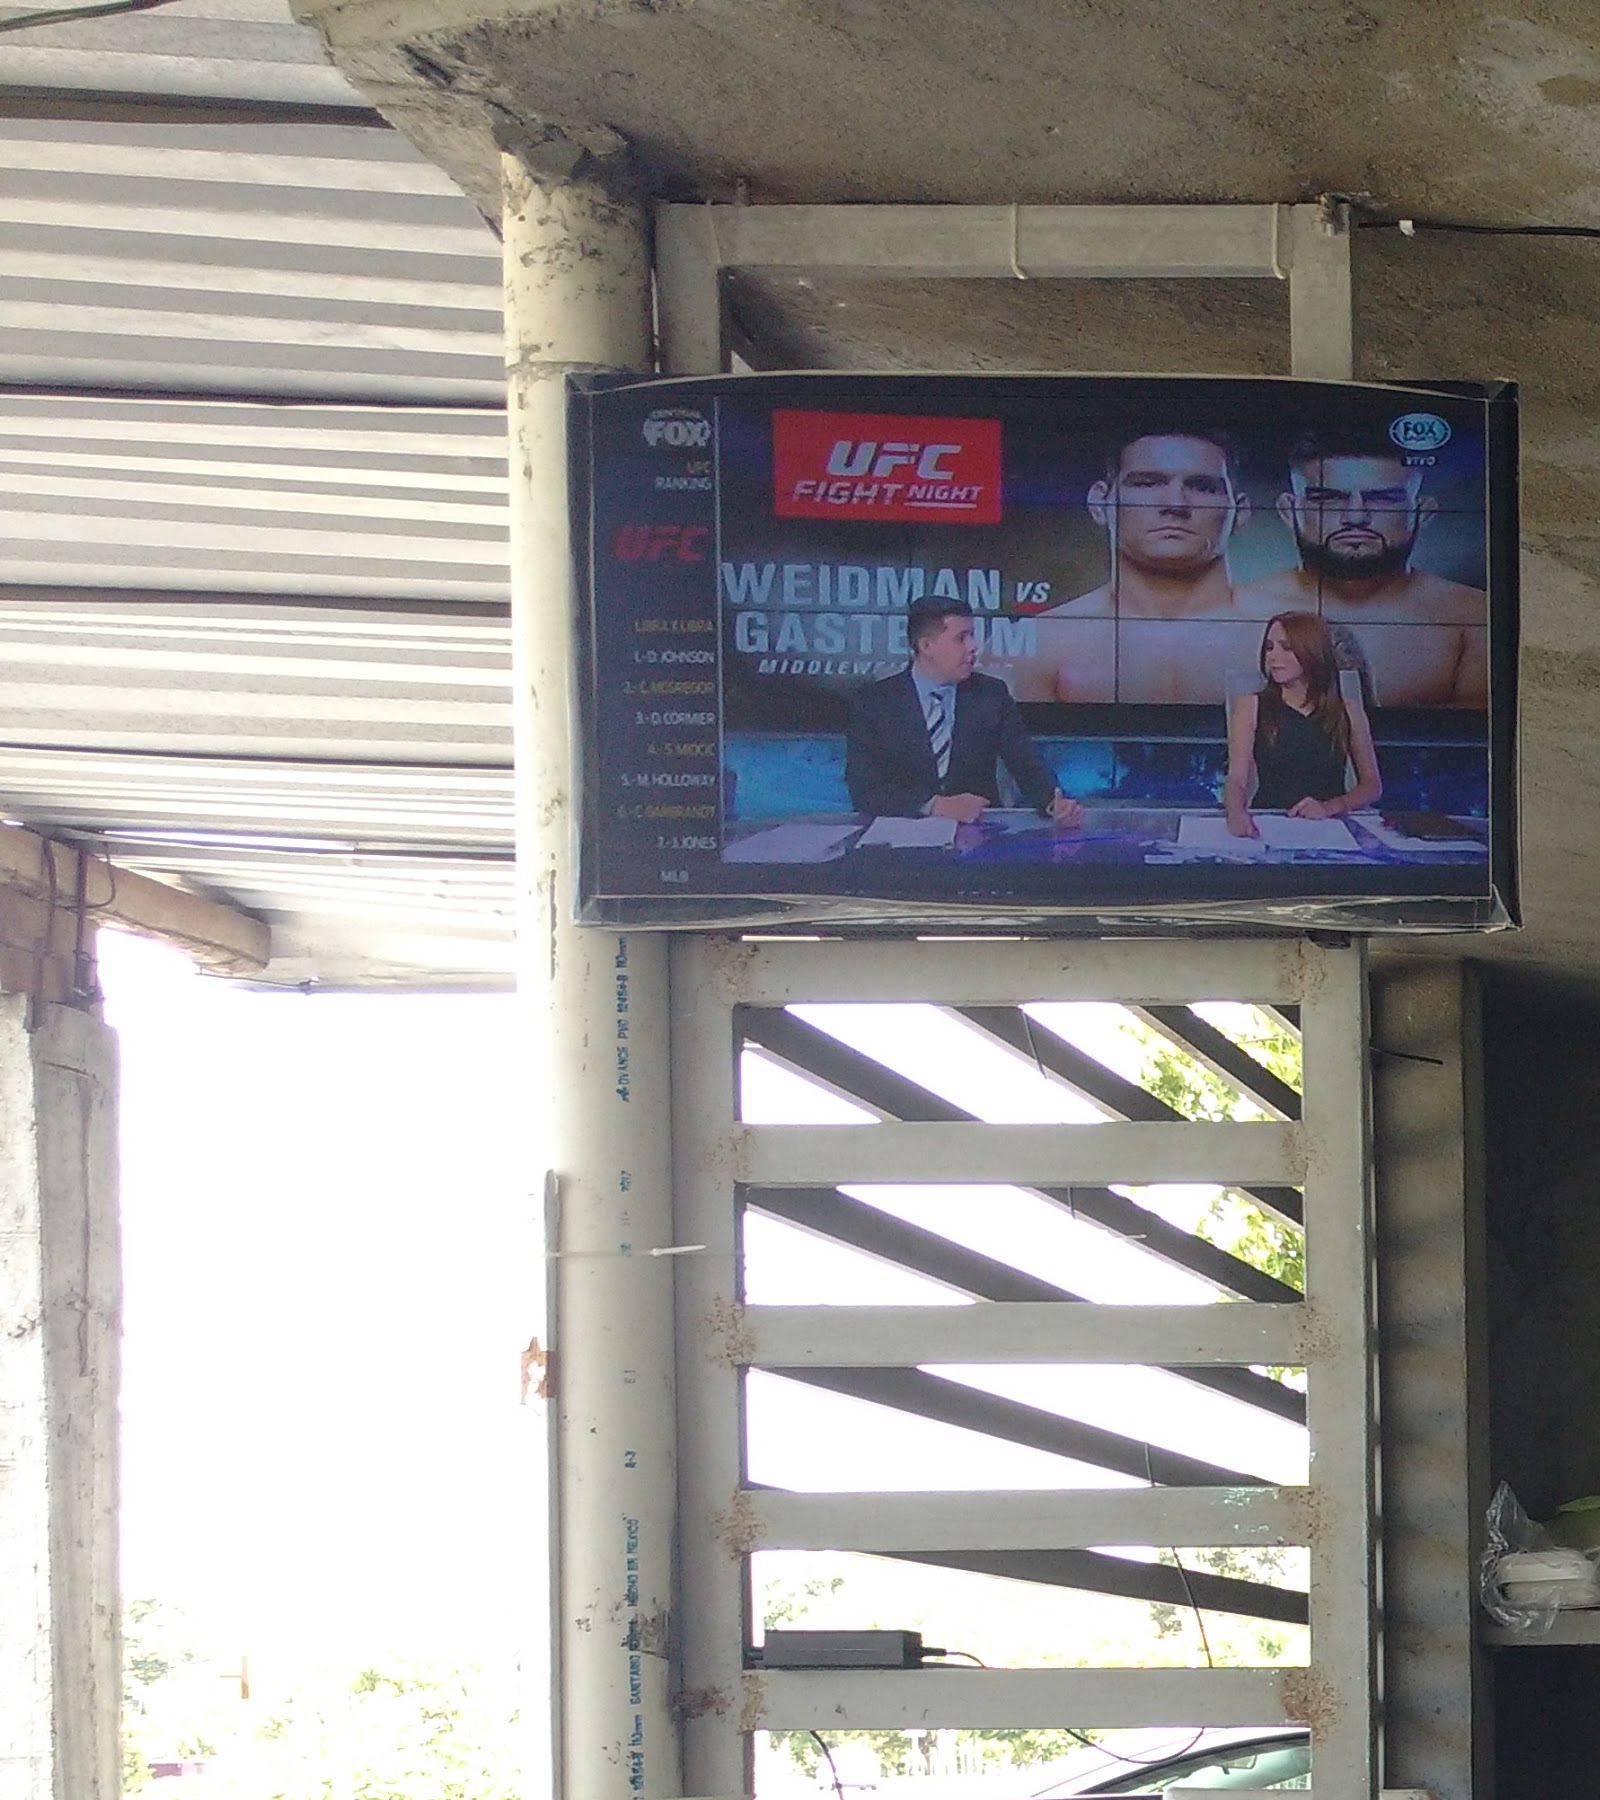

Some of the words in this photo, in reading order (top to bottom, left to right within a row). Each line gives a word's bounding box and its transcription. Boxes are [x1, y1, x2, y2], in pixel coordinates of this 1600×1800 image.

[643, 420, 711, 446] FOX
[1402, 421, 1437, 436] FOX
[826, 441, 961, 480] UFC
[654, 476, 713, 490] RANKING
[793, 480, 905, 505] FIGHT
[907, 484, 984, 501] NIGHT
[611, 525, 709, 562] UFC
[720, 562, 1001, 610] WEIDMAN
[735, 611, 1038, 657] GASTEM
[628, 1654, 642, 1705] SANITARIO
